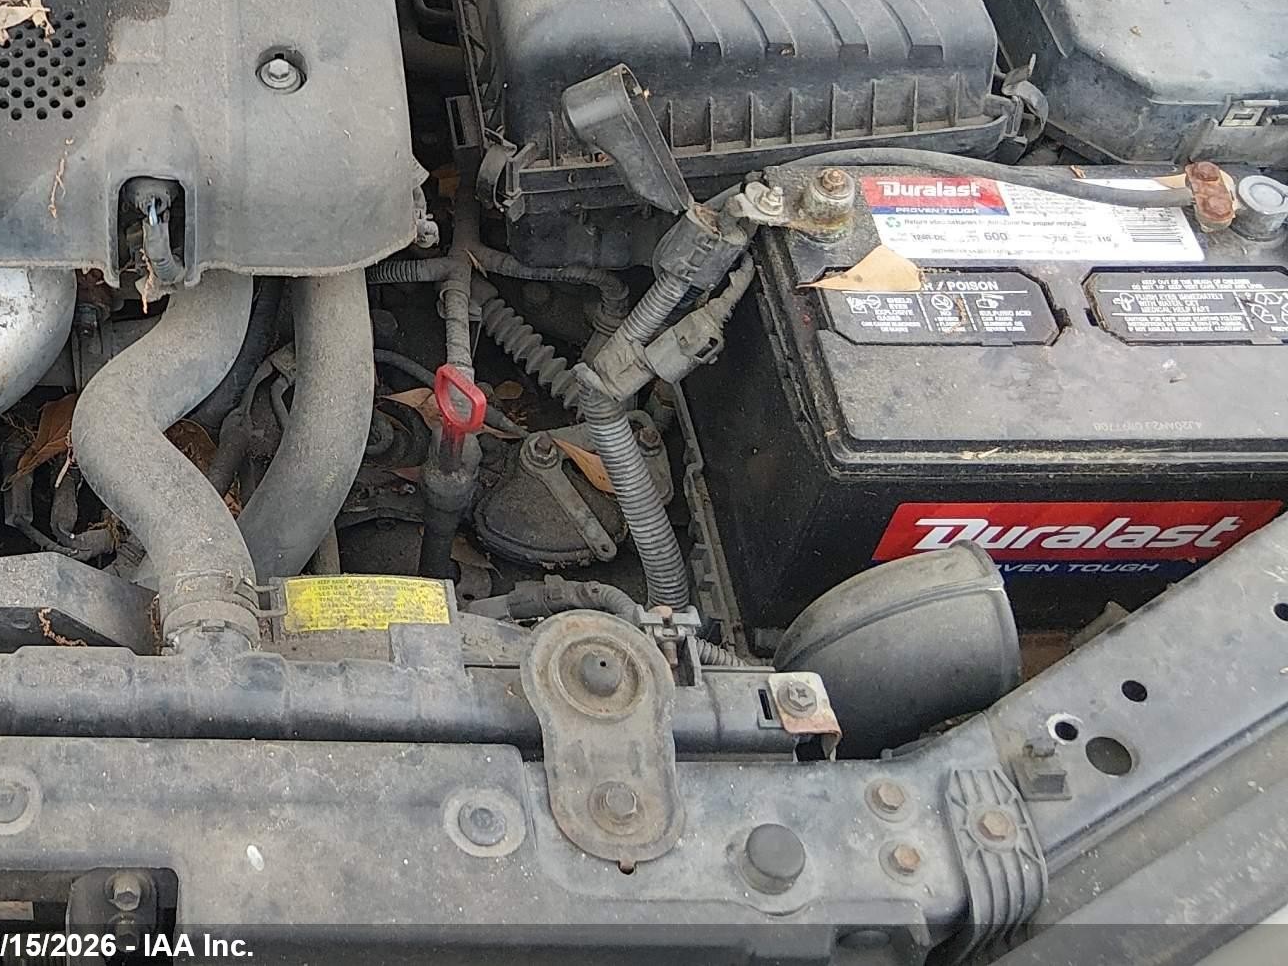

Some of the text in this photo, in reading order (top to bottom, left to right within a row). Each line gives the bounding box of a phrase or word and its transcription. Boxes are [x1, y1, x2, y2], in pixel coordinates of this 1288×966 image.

[876, 180, 982, 197] Duralast
[895, 207, 980, 215] PROVEN TOUGH
[983, 232, 1009, 242] 600
[947, 281, 1000, 291] POISON
[914, 516, 1242, 550] Duralast
[1068, 563, 1160, 573] TOUGH
